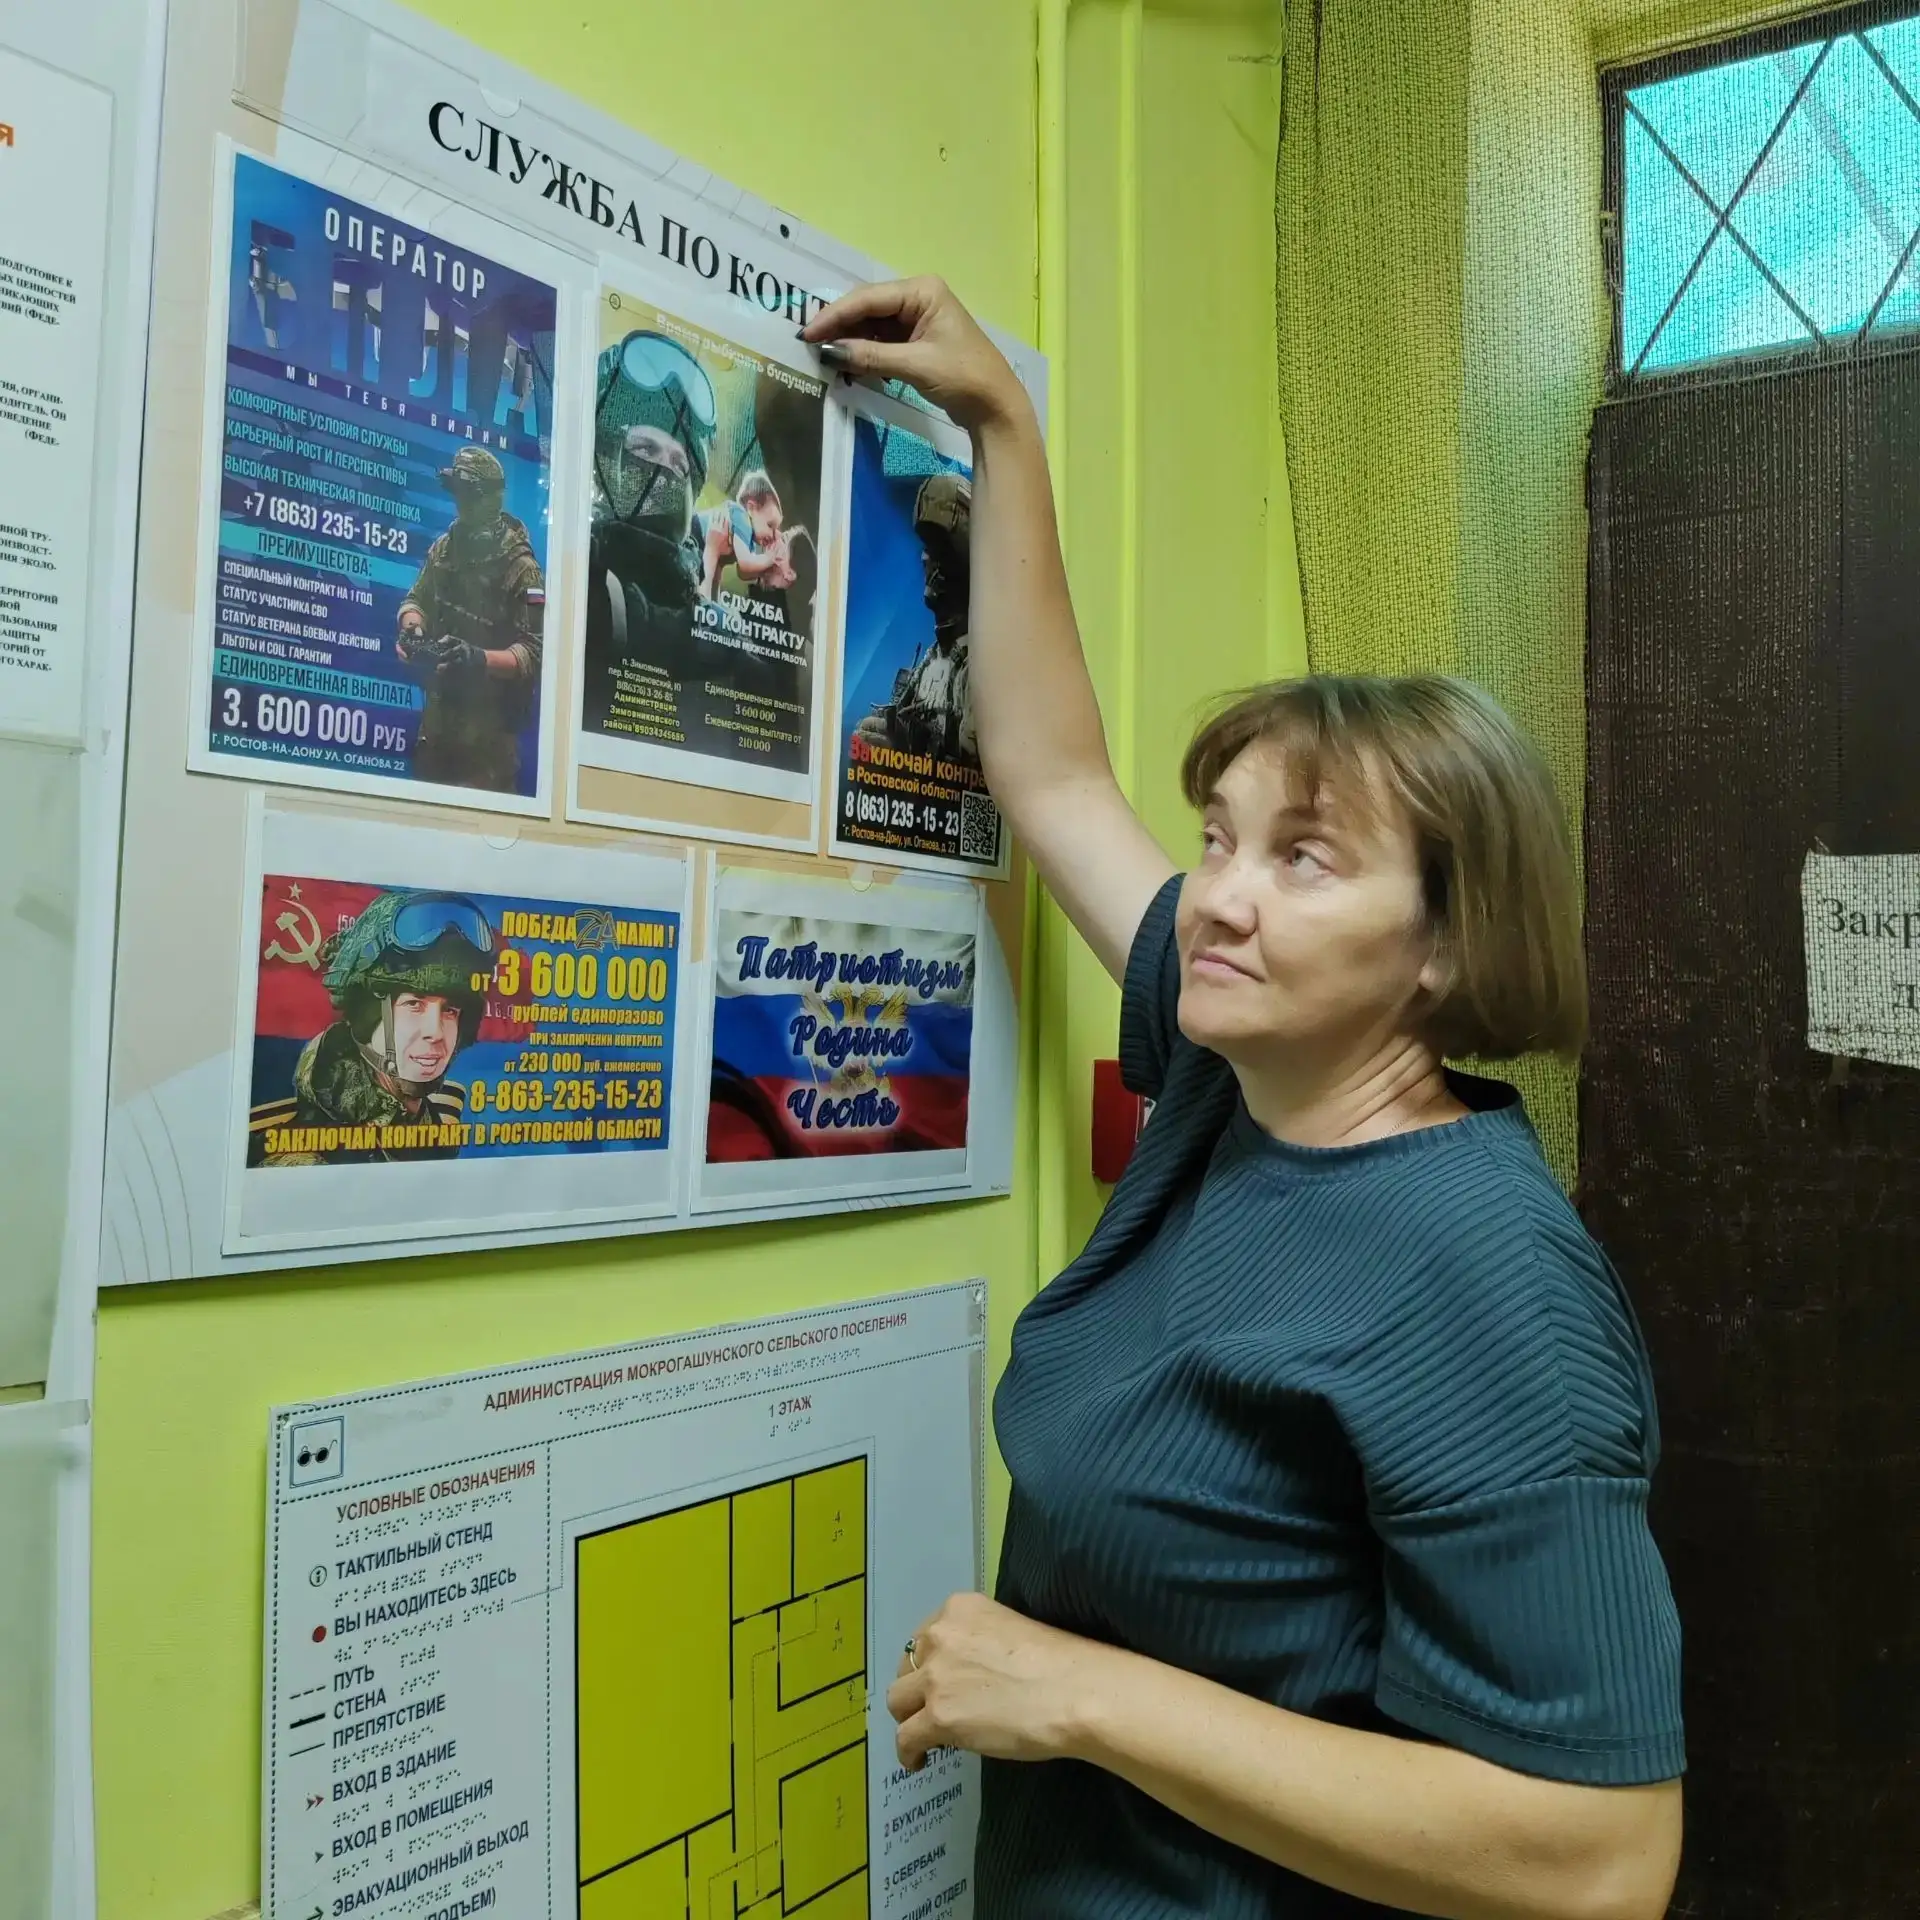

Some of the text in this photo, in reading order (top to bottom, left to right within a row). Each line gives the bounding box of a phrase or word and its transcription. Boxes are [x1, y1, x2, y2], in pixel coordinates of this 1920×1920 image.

[428, 101, 647, 247] СЛУЖБА
[658, 213, 721, 279] ПО
[324, 206, 486, 299] ОПЕРАТОР
[227, 386, 409, 457] КОМФОРТНЫЕ УСЛОВИЯ СЛУЖБЫ
[286, 365, 507, 449] МЫ ТЕБЯ ВИДИМ
[226, 419, 408, 487] КАРЬЕРНЫЙ РОСТ И ПЕРСПЕКТИВЫ
[224, 454, 421, 523] ВЫСОКАЯ ТЕХНИЧЕСКАЯ ПОДГОТОВКА
[243, 491, 408, 555] +7 (863) 235-15-23
[258, 532, 373, 577] ПРЕИМУЩЕСТВА:
[223, 560, 373, 607] СПЕЦИАЛЬНЫЙ КОНТРАКТ НА 1 ГОД
[223, 584, 328, 618] СТАТУС УЧАСТНИКА СВО
[693, 605, 805, 651] ПО КОНТРАКТУ
[720, 590, 785, 625] СЛУЖБА
[221, 632, 333, 666] ЛЬГОТЫ И СОЦ. ГАРАНТИИ
[222, 608, 381, 653] СТАТУС ВЕТЕРАНА БОЕВЫХ ДЕЙСТВИЙ
[690, 627, 808, 668] НАСТОЯЩАЯ МУЖСКАЯ РАБОТА
[219, 654, 413, 706] ЕДИНОВРЕМЕННАЯ ВЫПЛАТА
[614, 690, 678, 713] Администрация
[704, 681, 805, 715] Единовременная выплата
[222, 687, 407, 753] 3. 600 000 РУБ
[704, 713, 802, 744] Ежемесячная выплата от
[735, 703, 777, 724] 3 600 000
[211, 732, 405, 772] Г. РОСТОВ-НА-ДОНУ УЛ. ОГАНОВА 22
[738, 736, 771, 752] 210 000
[848, 734, 933, 777] Заключай
[847, 765, 961, 802] в Ростовской области
[845, 790, 855, 818] 8
[856, 789, 890, 827] (863)
[891, 799, 915, 829] 235
[501, 911, 577, 944] ПОБЕДА
[615, 920, 665, 948] НАМИ
[470, 949, 668, 1002] от 3 600 000
[736, 935, 965, 999] Патриотизм
[512, 1002, 570, 1024] рублей
[571, 1007, 665, 1026] единоразово
[529, 1032, 663, 1047] ПРИ ЗАКЛЮЧЕНИИ КОНТРАКТА
[789, 1014, 914, 1068] Родина
[504, 1060, 517, 1073] от
[518, 1051, 550, 1073] 230
[551, 1052, 582, 1073] 000
[583, 1061, 603, 1074] руб.
[469, 1079, 662, 1114] 8-863-235-15-23
[786, 1087, 901, 1130] Честь
[263, 1117, 662, 1155] ЗАКЛЮЧАЙ КОНТРАКТ В РОСТОВСКОЙ ОБЛАСТИ
[483, 1312, 908, 1412] АДМИНИСТРАЦИЯ МОКРОГАШУНСКОГО СЕЛЬСКОГО ПОСЕЛЕНИЯ
[768, 1395, 813, 1418] 1 ЭТАЖ
[336, 1459, 536, 1524] УСЛОВНЫЕ ОБОЗНАЧЕНИЯ
[335, 1521, 493, 1581] ТАКТИЛЬНЫЙ СТЕНД
[333, 1566, 517, 1637] ВЫ НАХОДИТЕСЬ ЗДЕСЬ
[333, 1664, 376, 1693] ПУТЬ
[332, 1693, 447, 1750] ПРЕПЯТСТВИЕ
[333, 1687, 387, 1720] СТЕНА
[332, 1739, 458, 1802] ВХОД В ЗДАНИЕ
[331, 1778, 494, 1858] ВХОД В ПОМЕЩЕНИЯ
[891, 1782, 963, 1832] БУХГАЛТЕРИЯ
[331, 1820, 530, 1917] ЭВАКУАЦИОННЫЙ ВЫХОД
[892, 1842, 947, 1886] СБЕРБАНК
[934, 1878, 968, 1909] ОТДЕЛ
